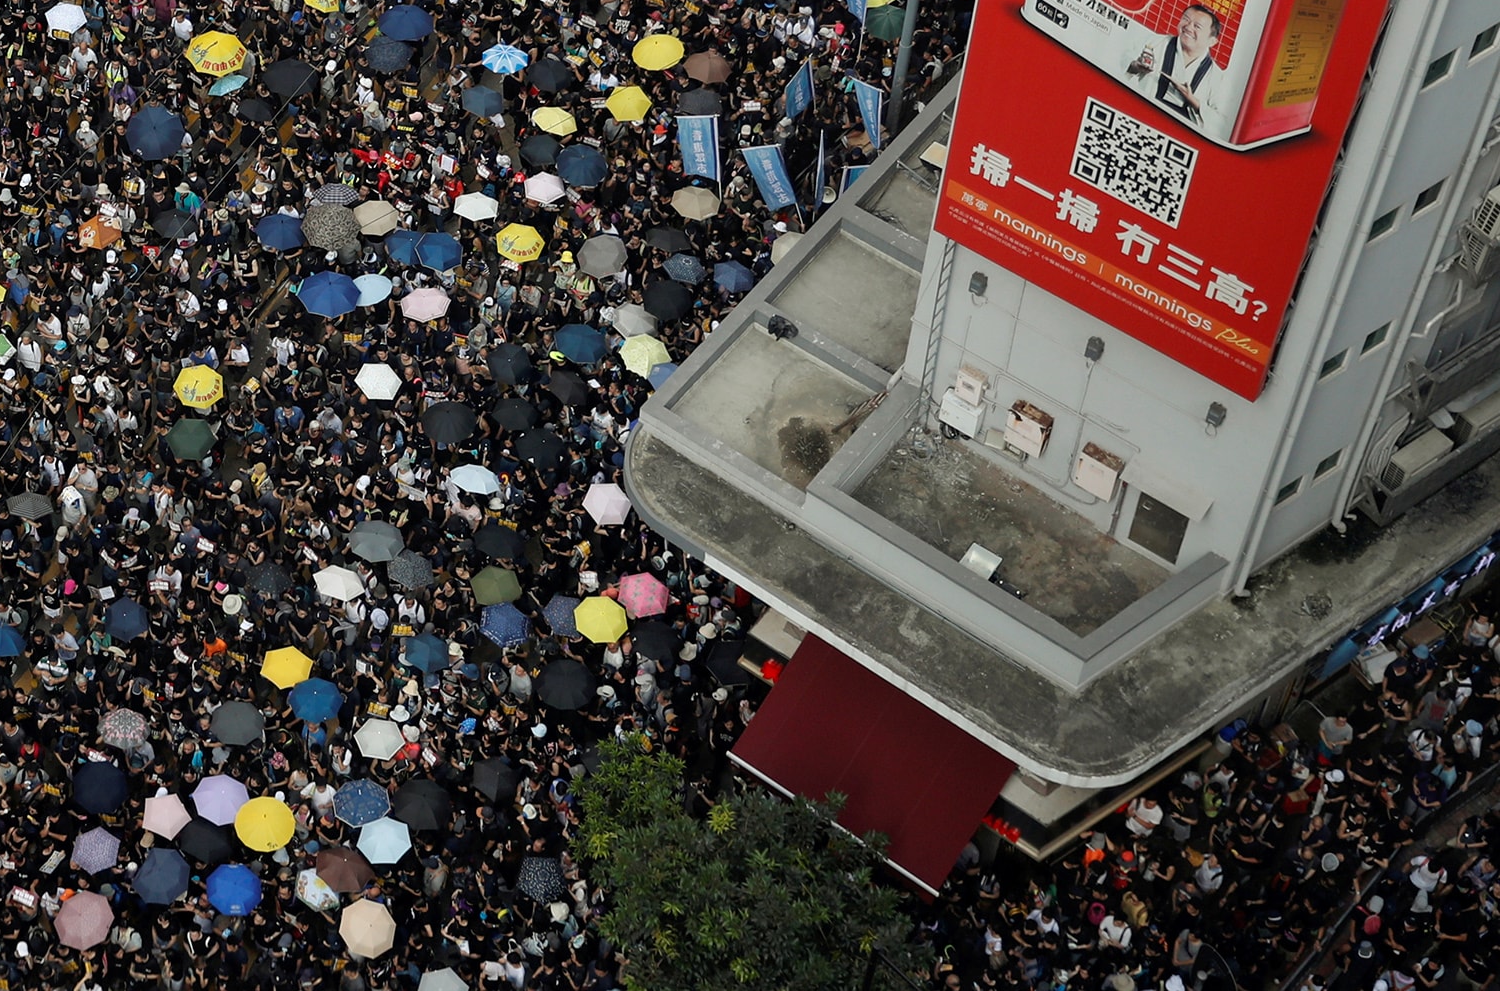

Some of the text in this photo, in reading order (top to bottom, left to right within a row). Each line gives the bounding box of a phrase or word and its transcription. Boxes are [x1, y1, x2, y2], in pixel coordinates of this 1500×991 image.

[970, 143, 1101, 234] 掃一掃
[993, 206, 1088, 265] mannings
[1114, 272, 1213, 332] mannings
